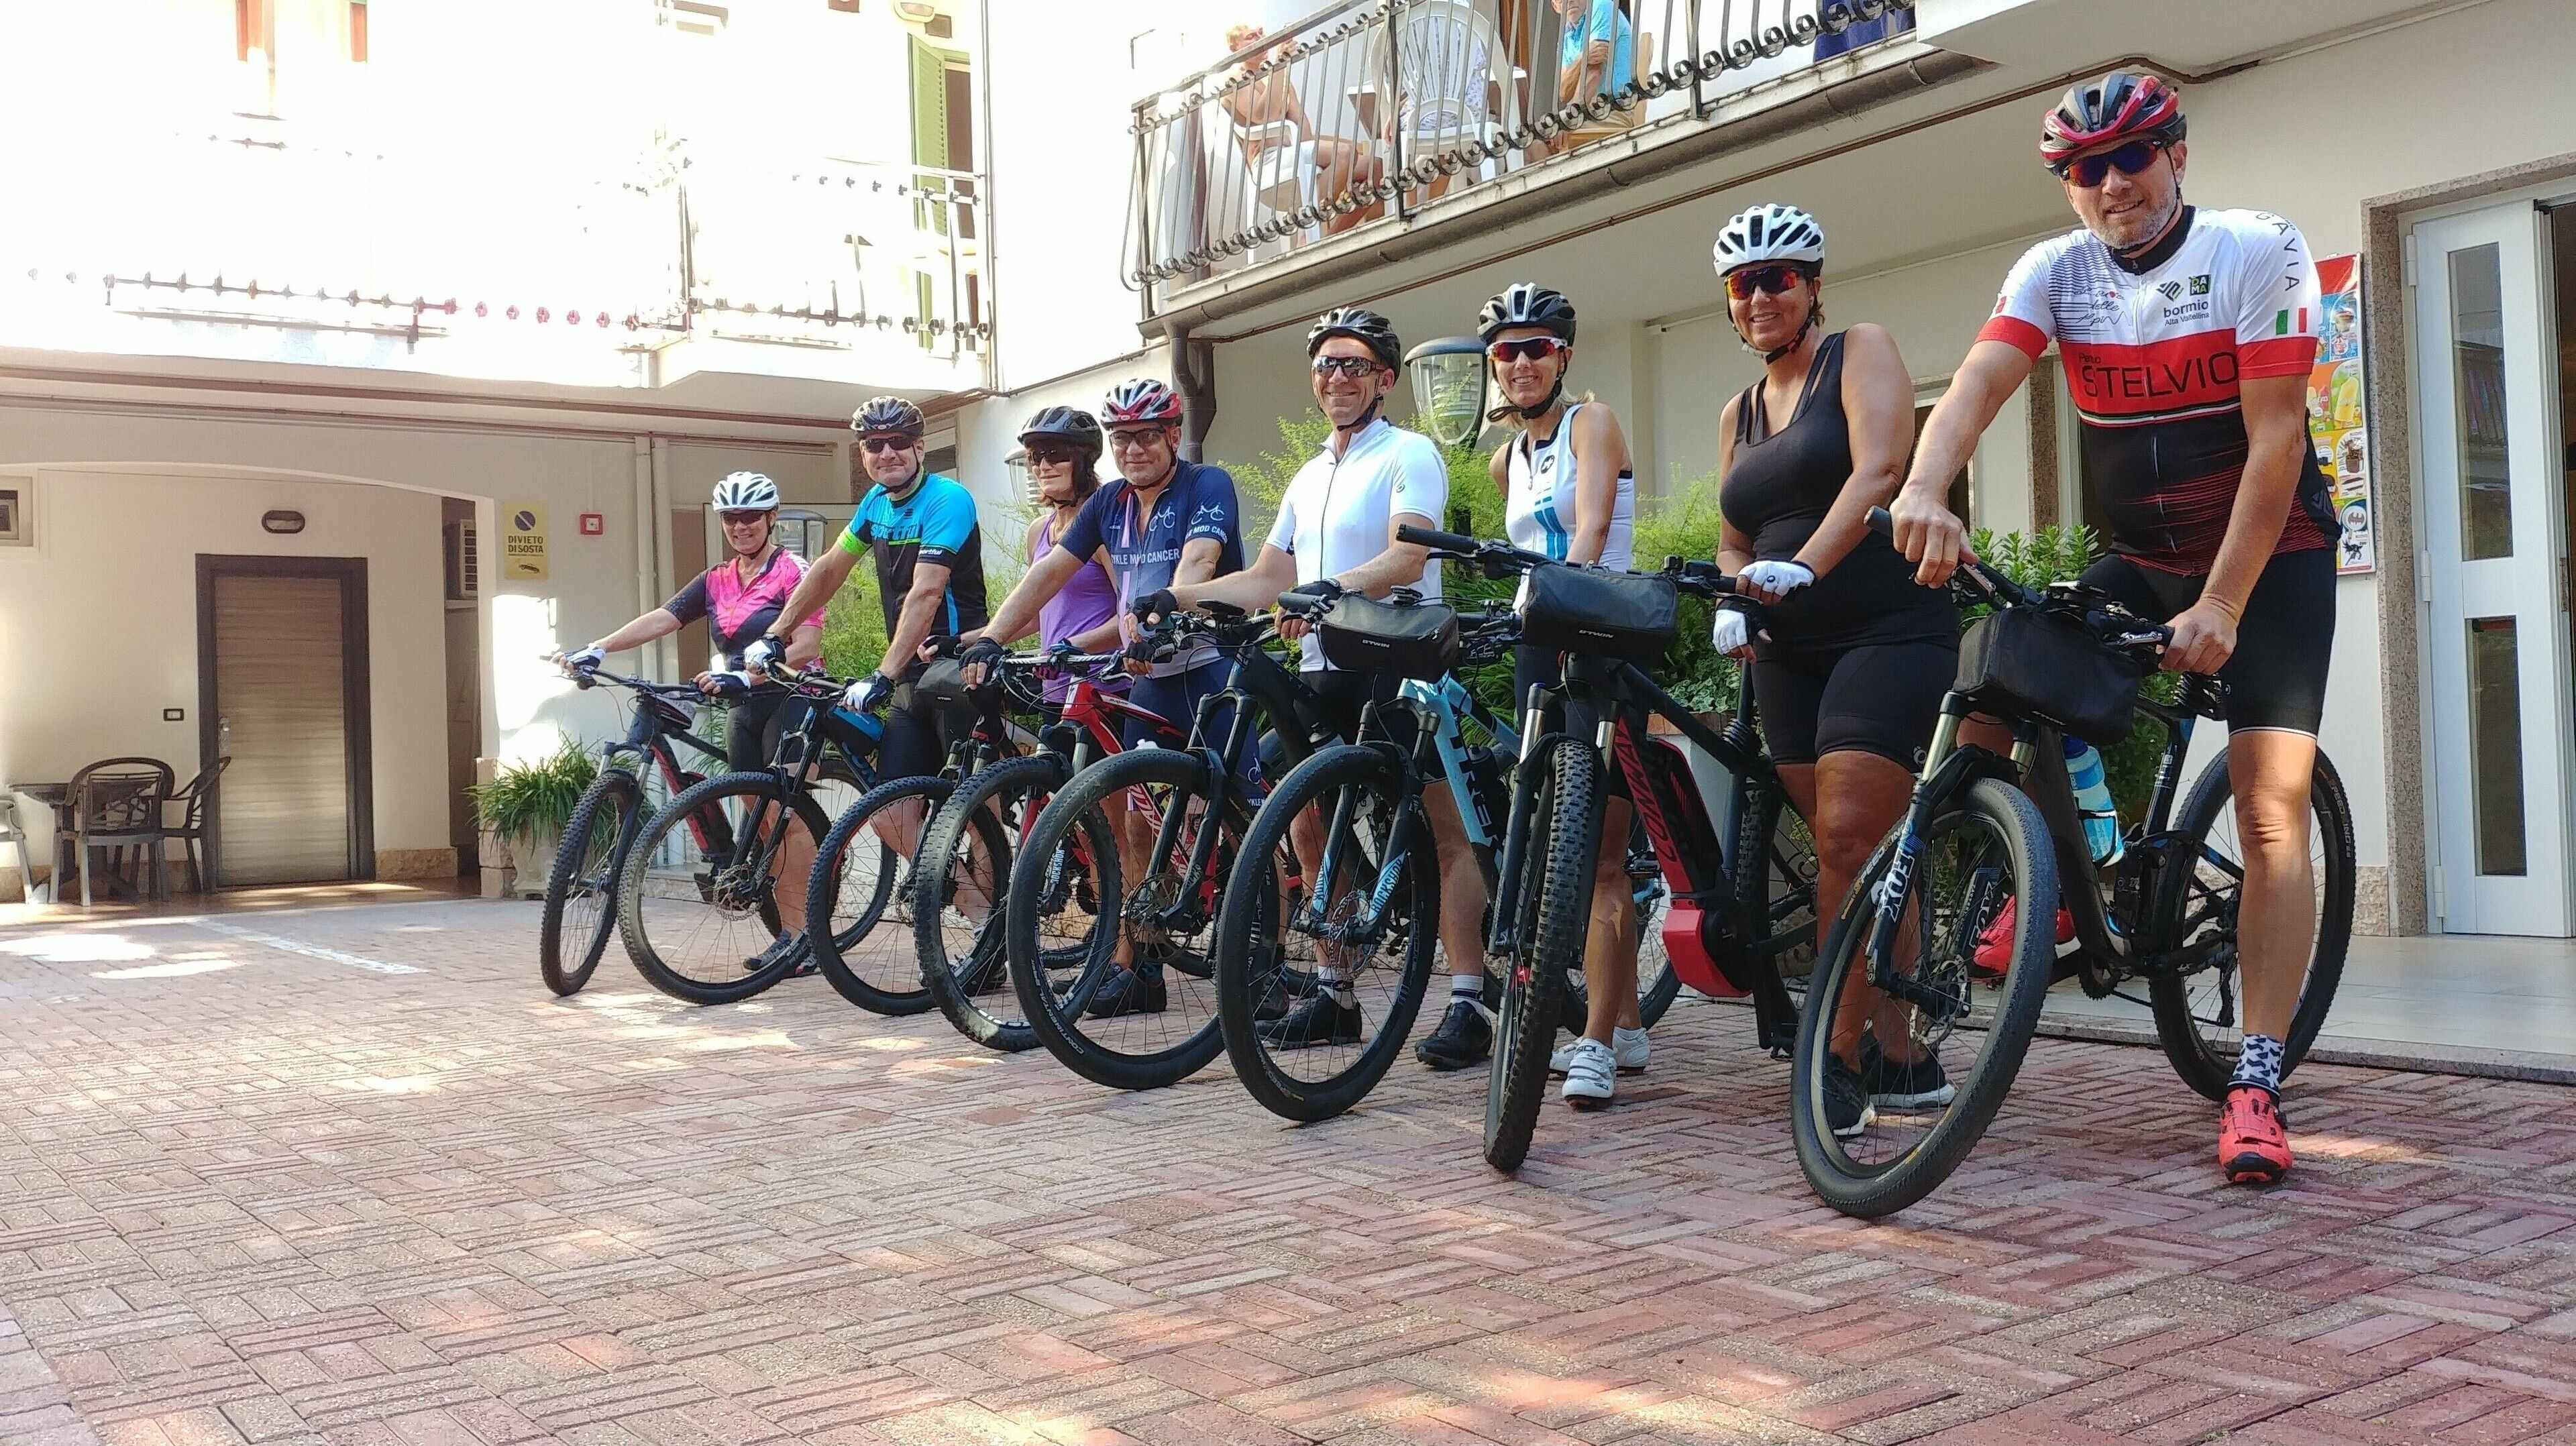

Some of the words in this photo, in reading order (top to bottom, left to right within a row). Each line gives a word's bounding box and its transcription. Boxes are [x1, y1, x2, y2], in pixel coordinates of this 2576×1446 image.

[2255, 213, 2300, 291] GAVIA
[2163, 299, 2209, 319] bormio
[2164, 317, 2179, 327] Alta
[2180, 311, 2210, 323] Valtellina
[2082, 351, 2239, 398] STELVIO
[508, 535, 544, 545] DIVIETO
[508, 545, 517, 553] DI
[518, 545, 544, 553] SOSTA
[1148, 547, 1180, 564] CANCER
